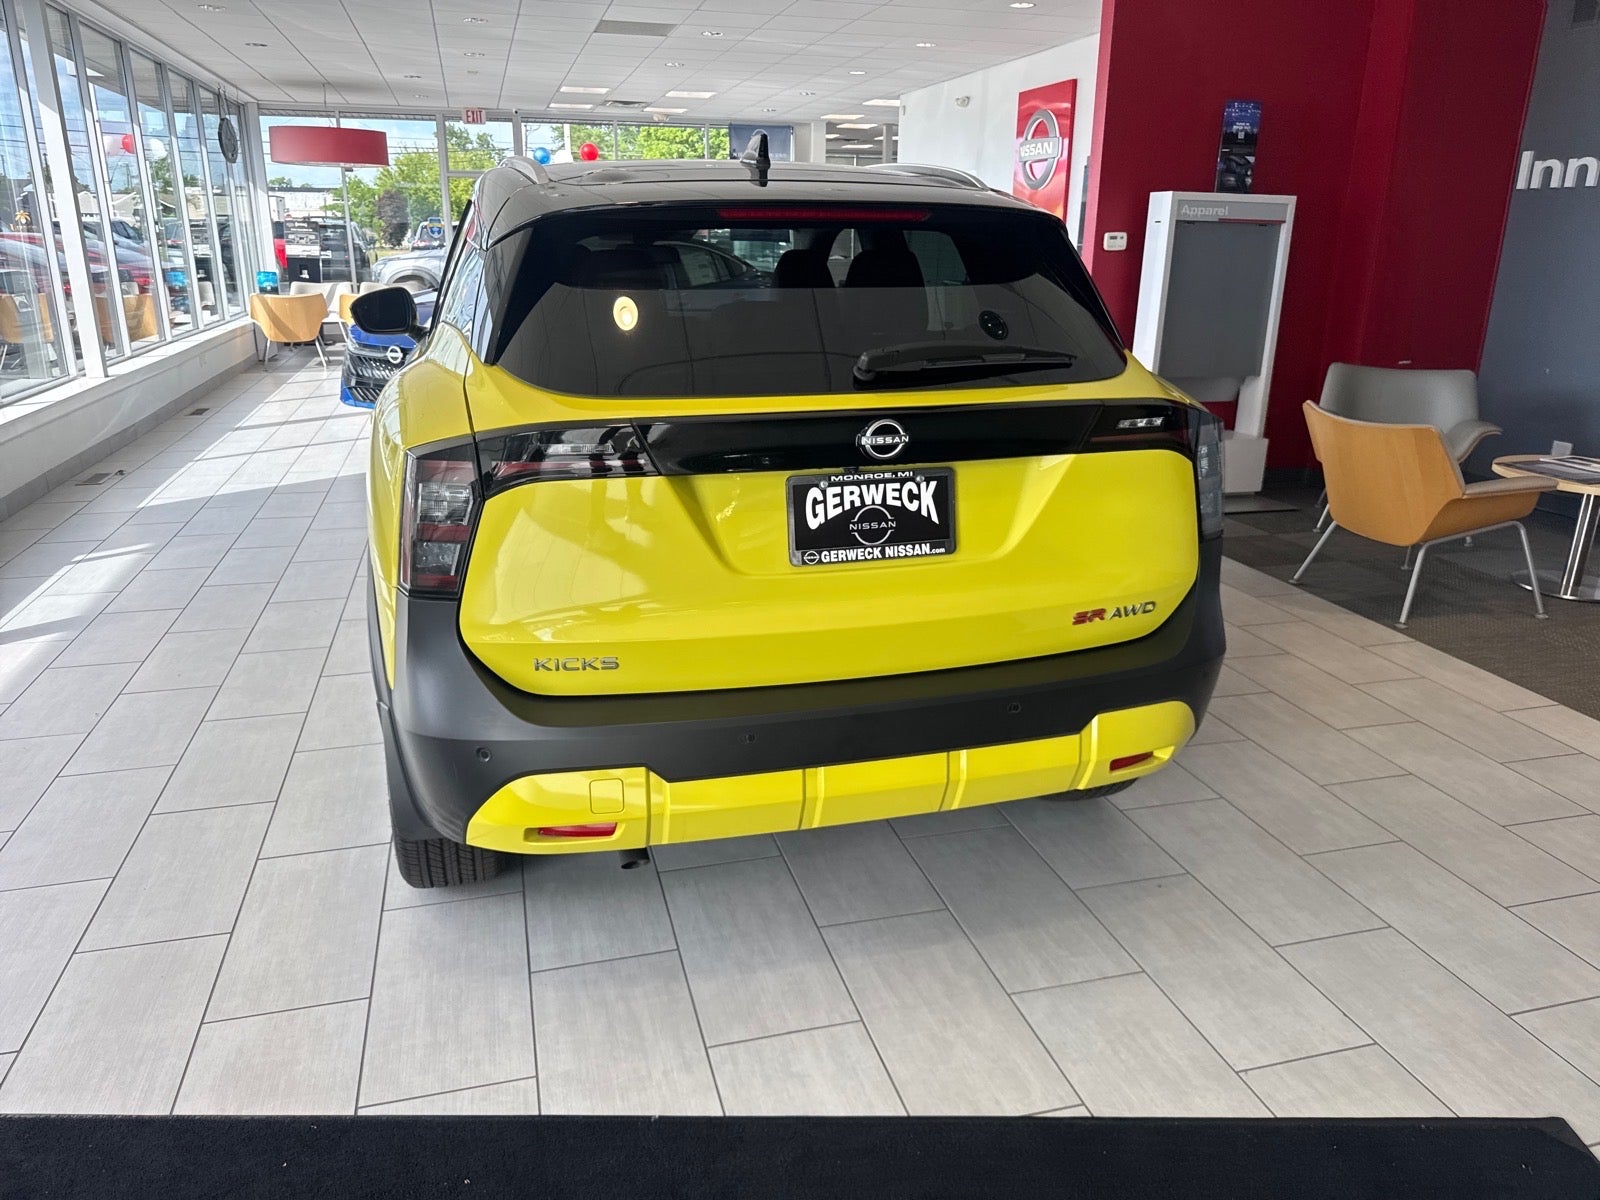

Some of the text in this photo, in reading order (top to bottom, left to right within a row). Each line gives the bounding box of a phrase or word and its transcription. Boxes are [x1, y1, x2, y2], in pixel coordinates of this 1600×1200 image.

[466, 109, 483, 124] EXIT
[1516, 150, 1600, 190] Inn
[1181, 204, 1229, 218] Apparel
[861, 435, 909, 446] NISSAN
[805, 480, 940, 531] GERWECK
[849, 520, 897, 531] NISSAN
[821, 547, 883, 563] GERWECK
[1072, 601, 1156, 626] SR AWD
[534, 656, 620, 672] KICKS
